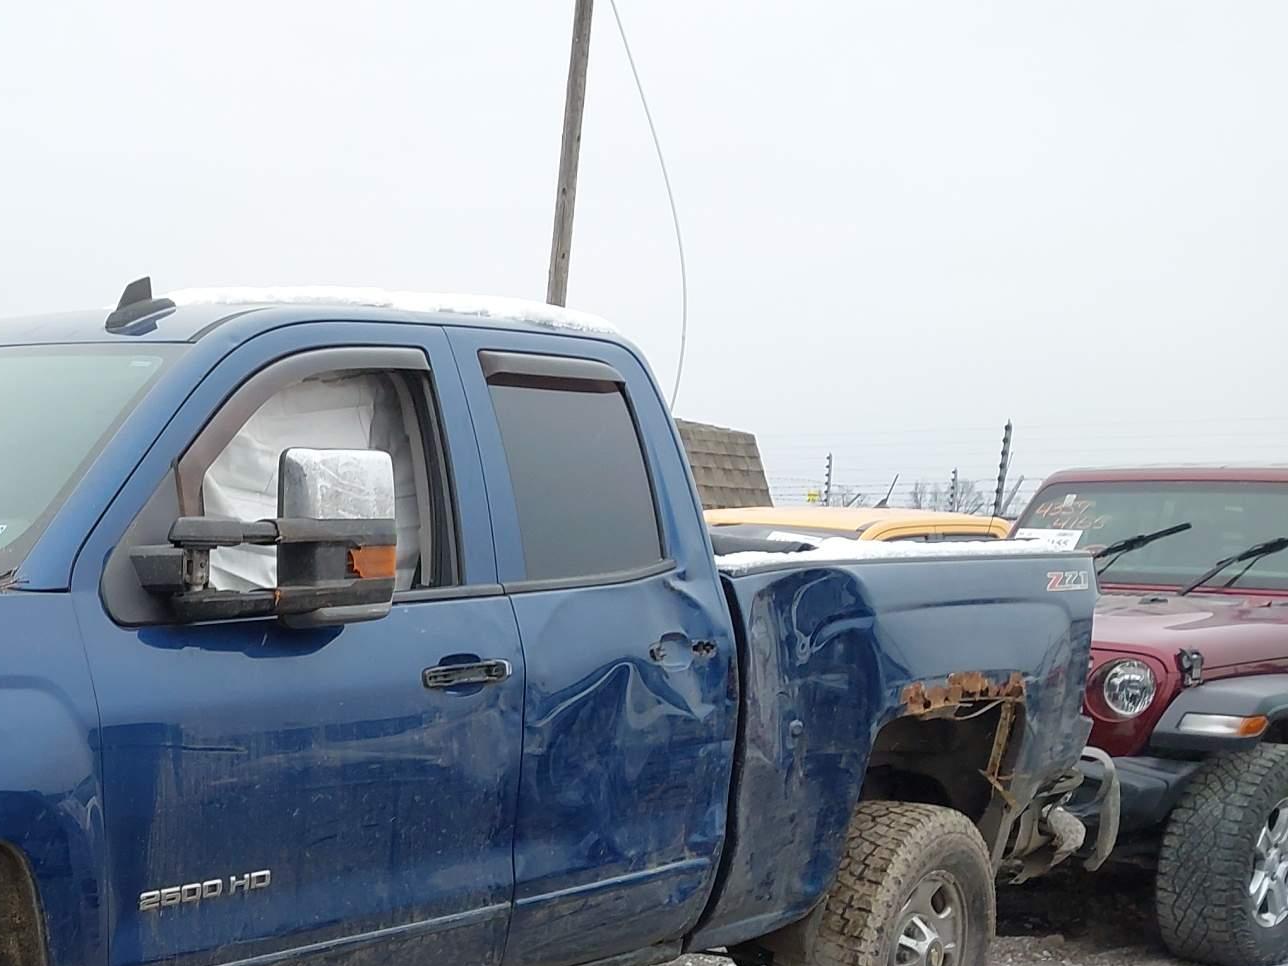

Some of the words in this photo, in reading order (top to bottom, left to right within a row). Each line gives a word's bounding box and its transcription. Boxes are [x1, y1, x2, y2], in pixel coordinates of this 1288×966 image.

[1046, 570, 1089, 592] Z71
[139, 878, 223, 912] 2500
[229, 869, 271, 896] HD
